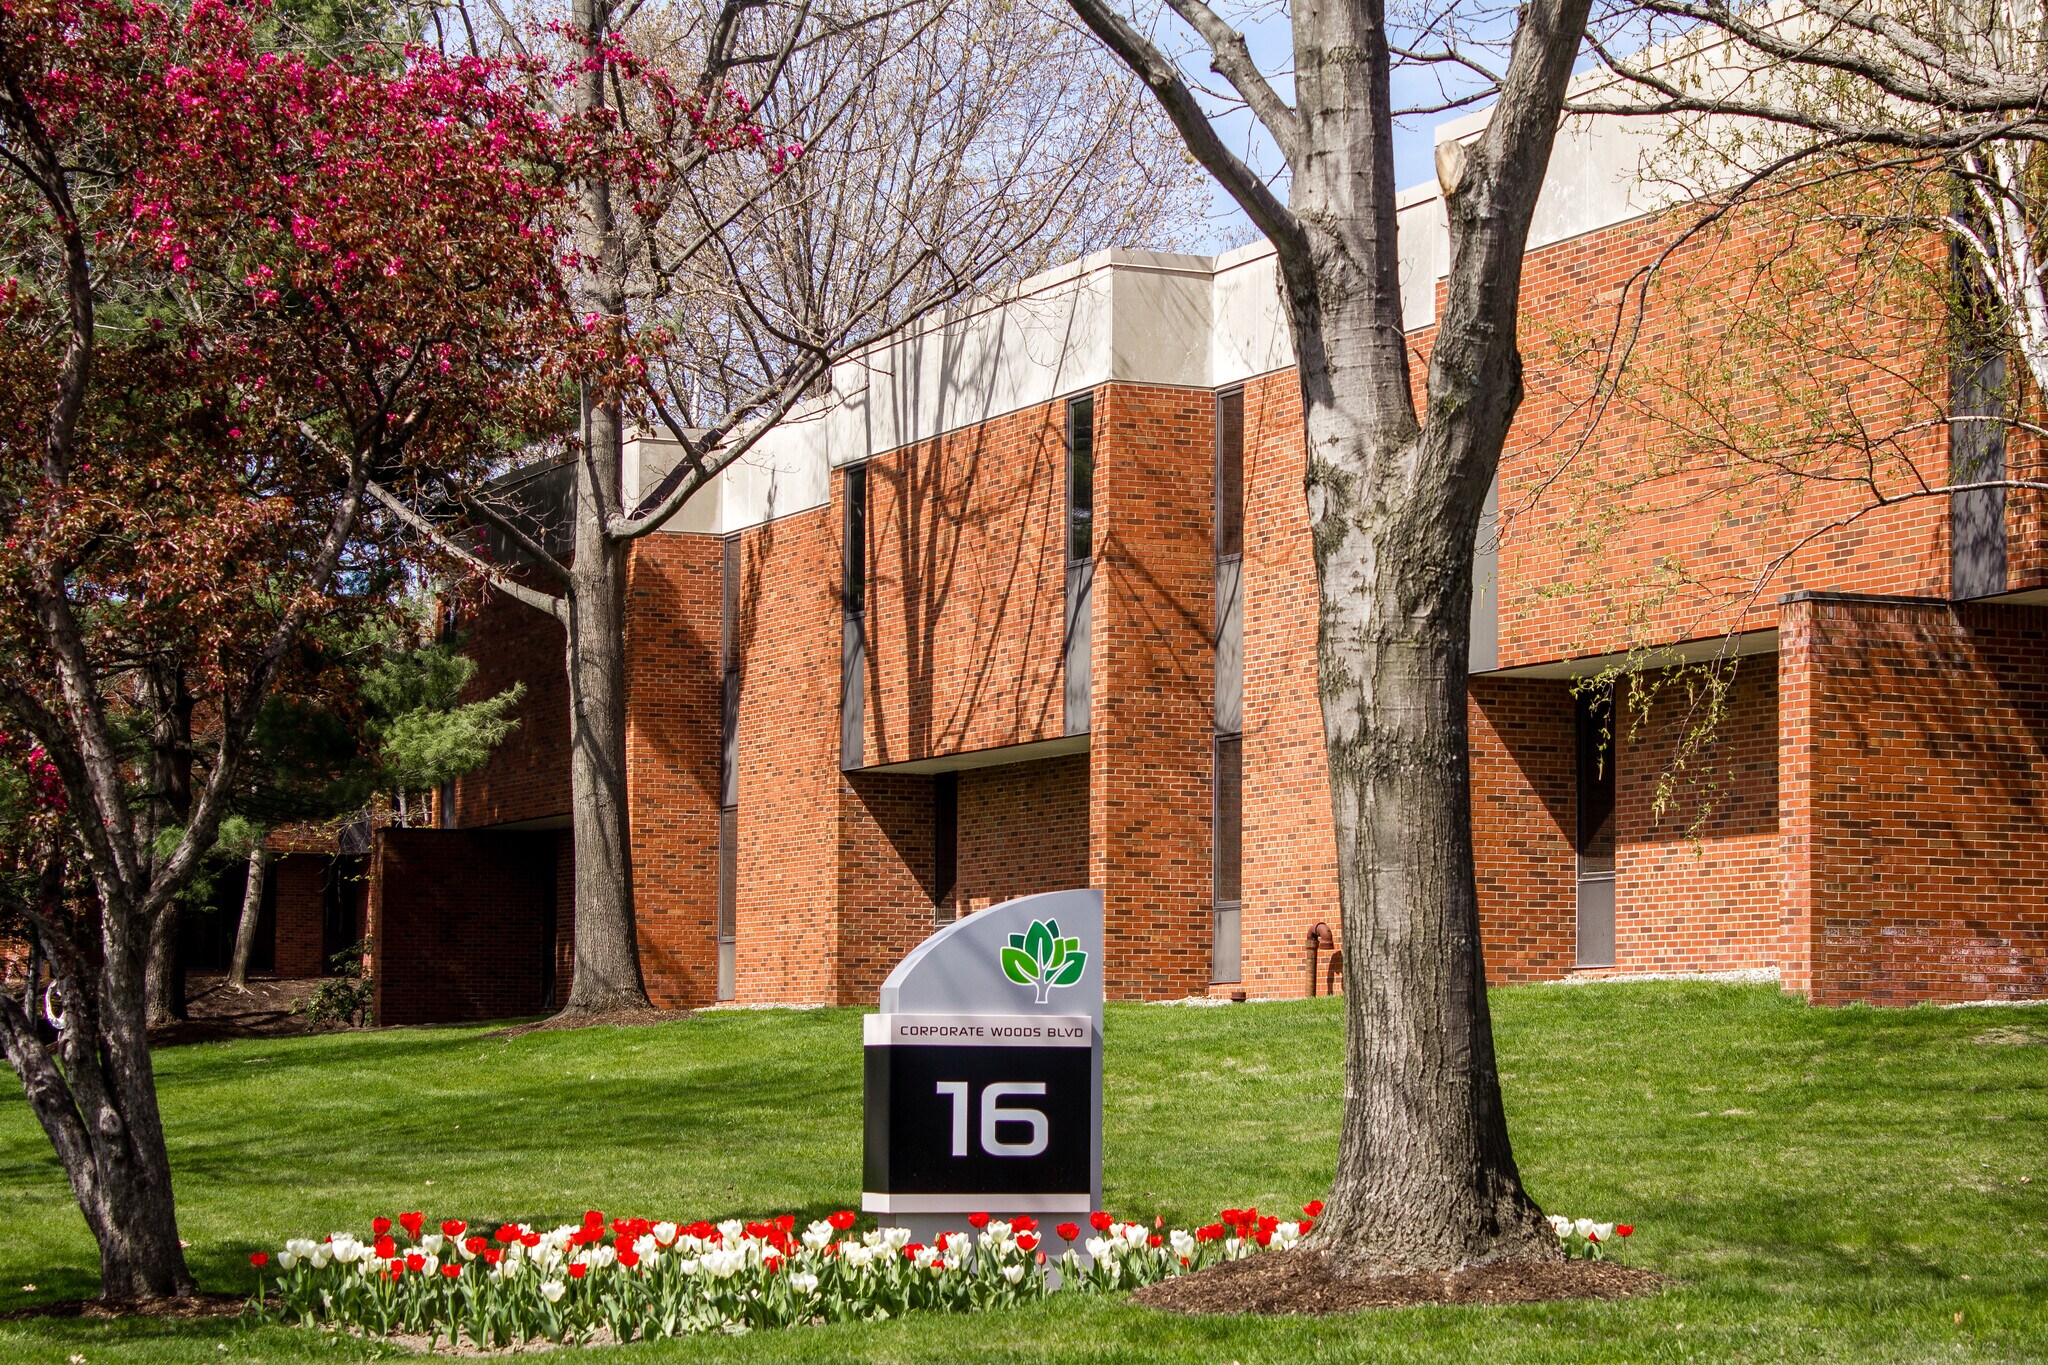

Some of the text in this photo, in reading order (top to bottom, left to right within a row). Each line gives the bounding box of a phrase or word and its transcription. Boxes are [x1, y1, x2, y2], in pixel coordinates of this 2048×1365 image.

[900, 1026, 1084, 1038] CORPORATE WOODS BLVD
[936, 1081, 1049, 1157] 16
